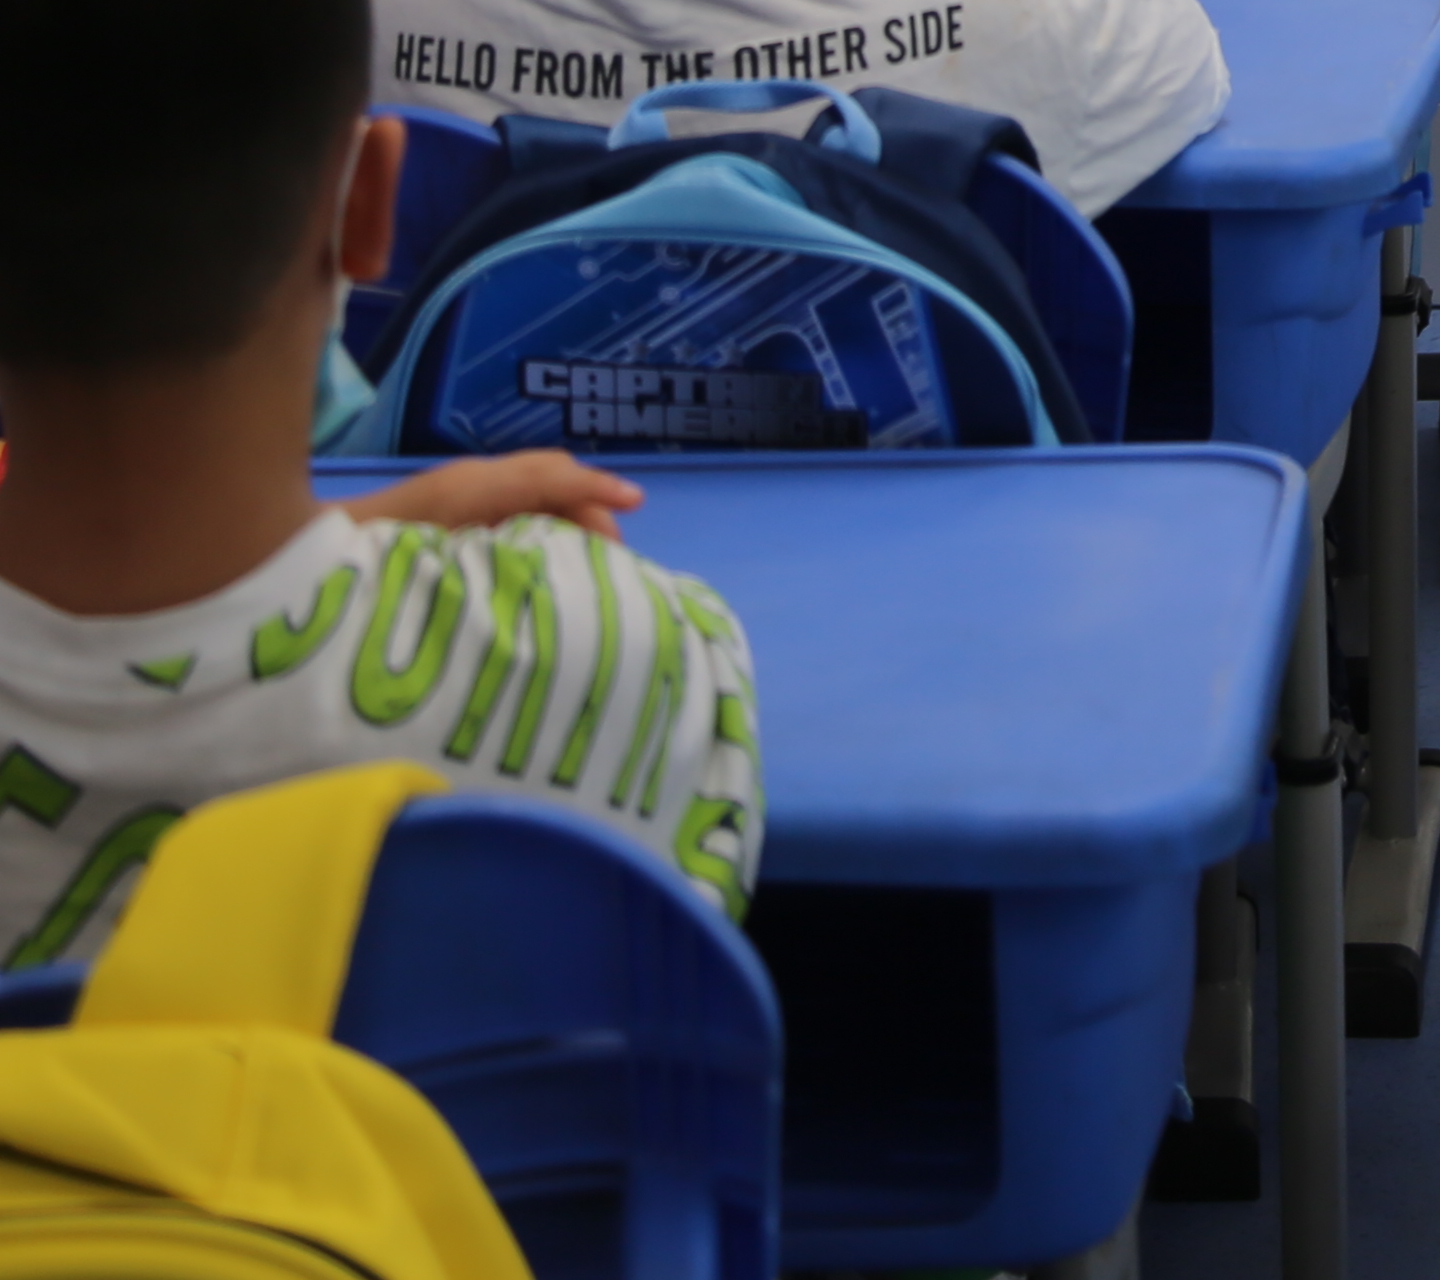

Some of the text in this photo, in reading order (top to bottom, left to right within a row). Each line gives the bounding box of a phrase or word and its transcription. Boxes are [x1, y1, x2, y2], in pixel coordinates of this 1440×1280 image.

[394, 31, 496, 90] HELLO
[512, 48, 624, 99] FROM
[734, 26, 868, 81] OTHER
[883, 4, 964, 64] SIDE
